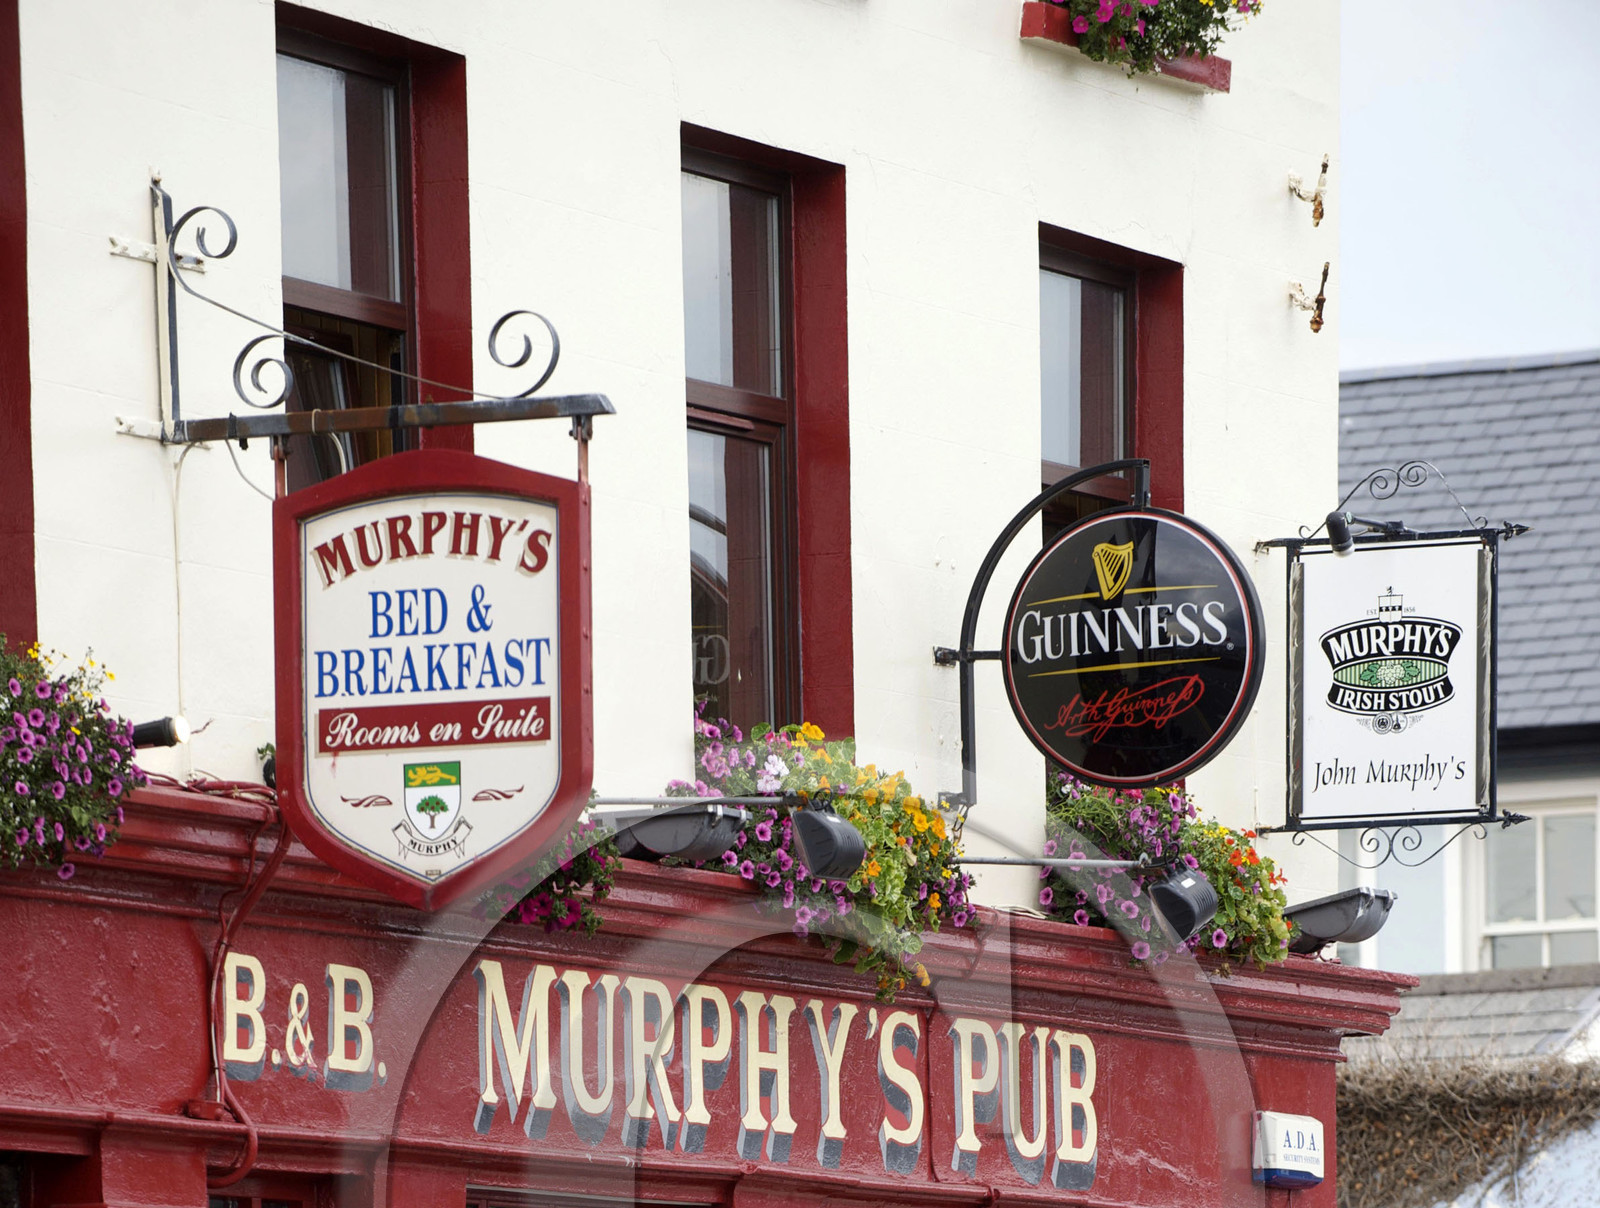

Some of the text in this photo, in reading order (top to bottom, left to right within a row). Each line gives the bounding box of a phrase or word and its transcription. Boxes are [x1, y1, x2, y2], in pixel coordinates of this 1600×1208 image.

[311, 511, 553, 588] MURPHY'S
[367, 583, 494, 639] BED &
[1017, 600, 1228, 665] GUINNESS
[314, 637, 552, 698] BREAKFAST
[1327, 622, 1453, 666] MURPHY'S
[1334, 680, 1446, 712] IRISH STOUT
[325, 703, 545, 749] Rooms en Suite
[1311, 752, 1467, 794] John Murphy's
[408, 838, 459, 855] MURPHY
[474, 958, 1099, 1175] MURPHY'S PUB
